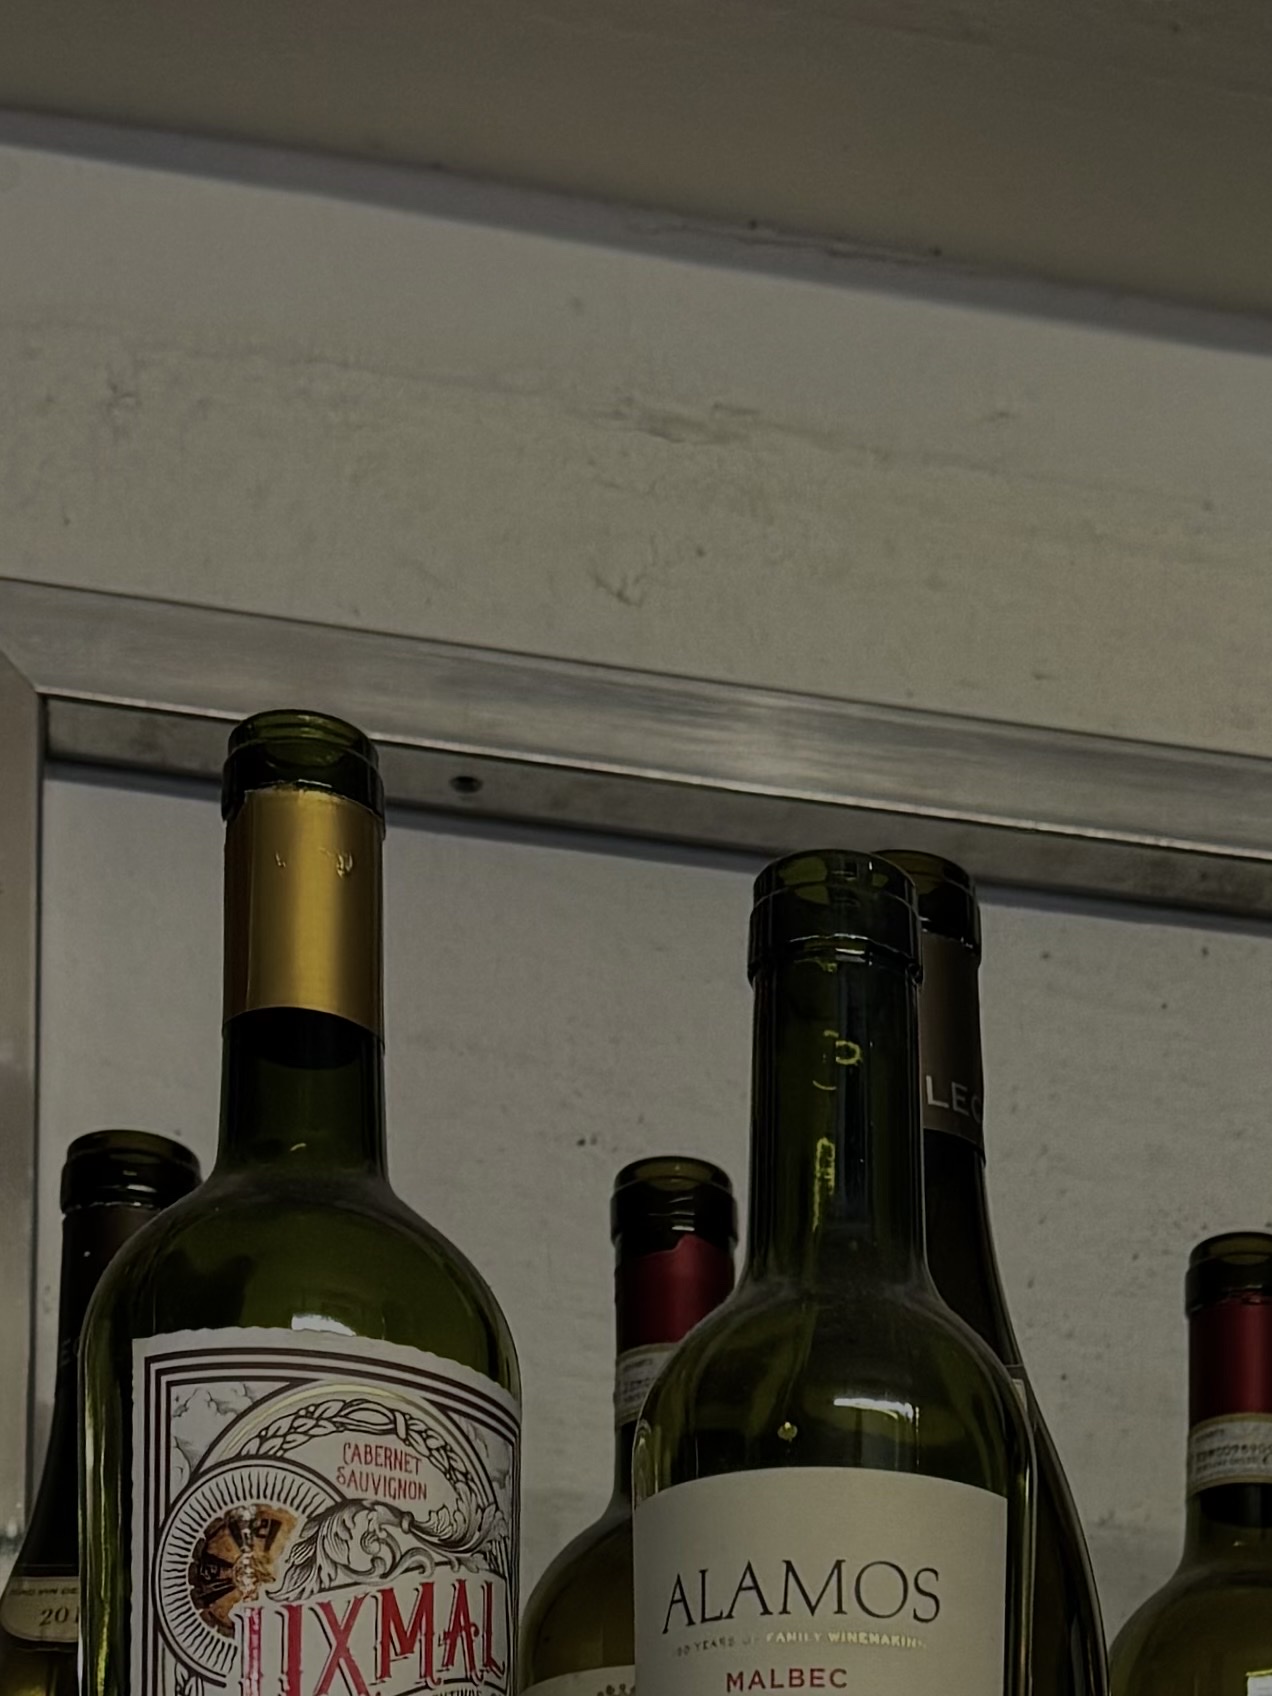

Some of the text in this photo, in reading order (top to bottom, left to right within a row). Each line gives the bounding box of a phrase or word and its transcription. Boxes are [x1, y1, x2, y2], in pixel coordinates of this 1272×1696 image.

[343, 1443, 421, 1475] CABERNET
[336, 1467, 427, 1500] SAUVIGNON
[662, 1559, 940, 1635] ALAMOS
[39, 1607, 79, 1626] 201
[766, 1632, 822, 1643] FAMILY
[726, 1667, 848, 1692] MALBEC
